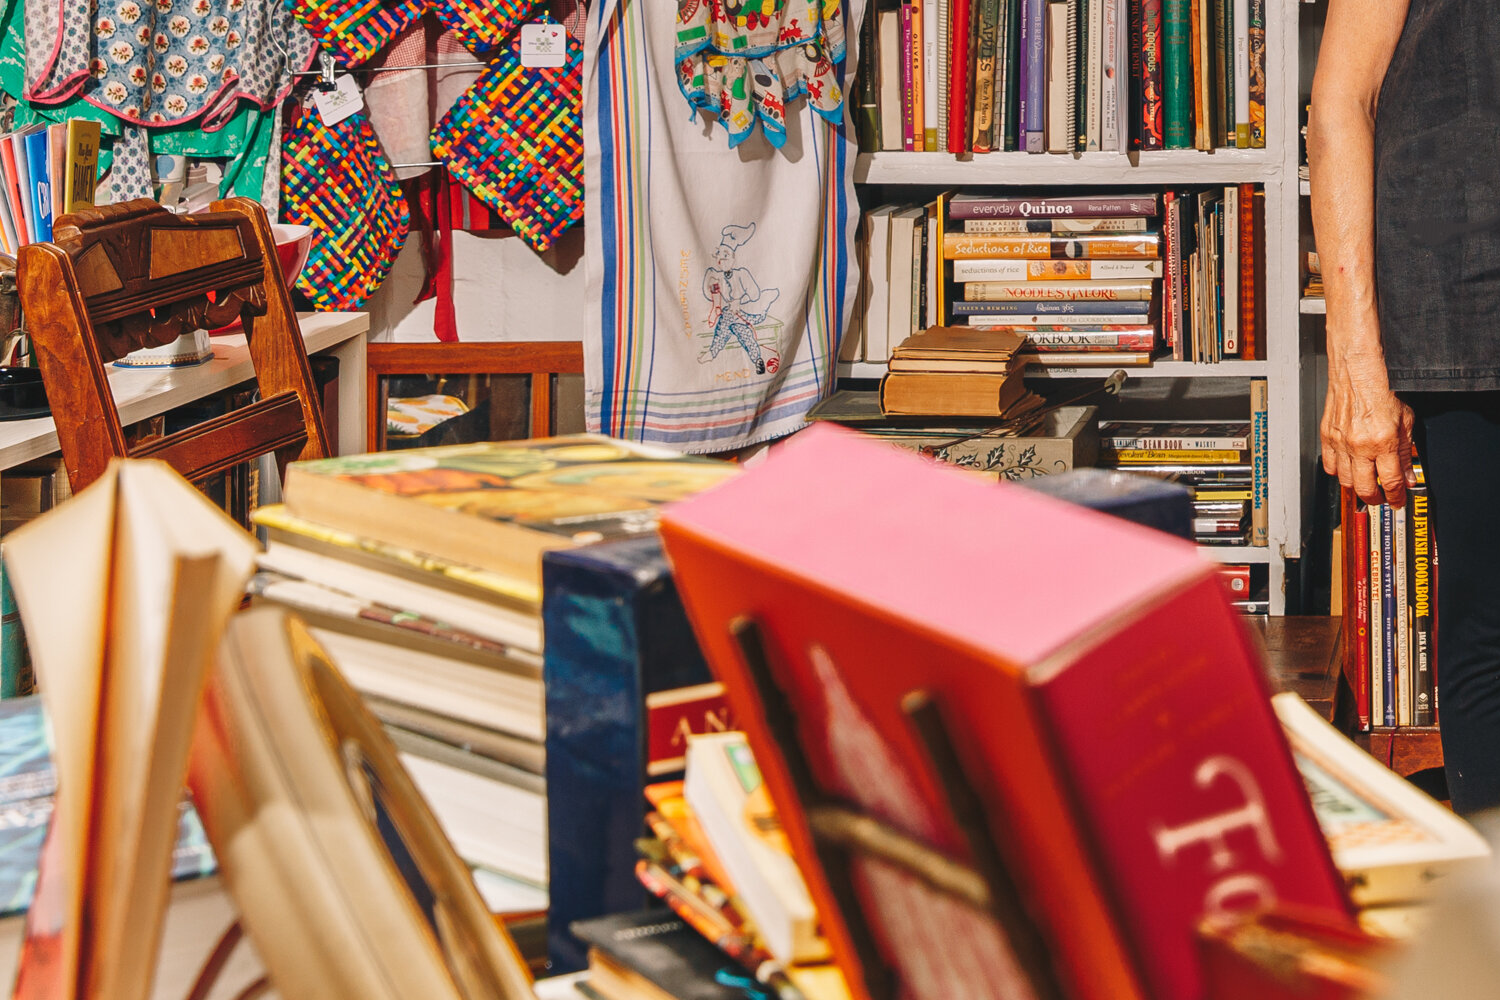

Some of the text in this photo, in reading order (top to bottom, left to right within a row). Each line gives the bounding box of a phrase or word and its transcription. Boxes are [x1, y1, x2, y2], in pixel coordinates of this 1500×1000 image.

[973, 202, 1074, 216] everyday Quinoa
[1413, 496, 1430, 618] ALL JEWISH COOKBOOK
